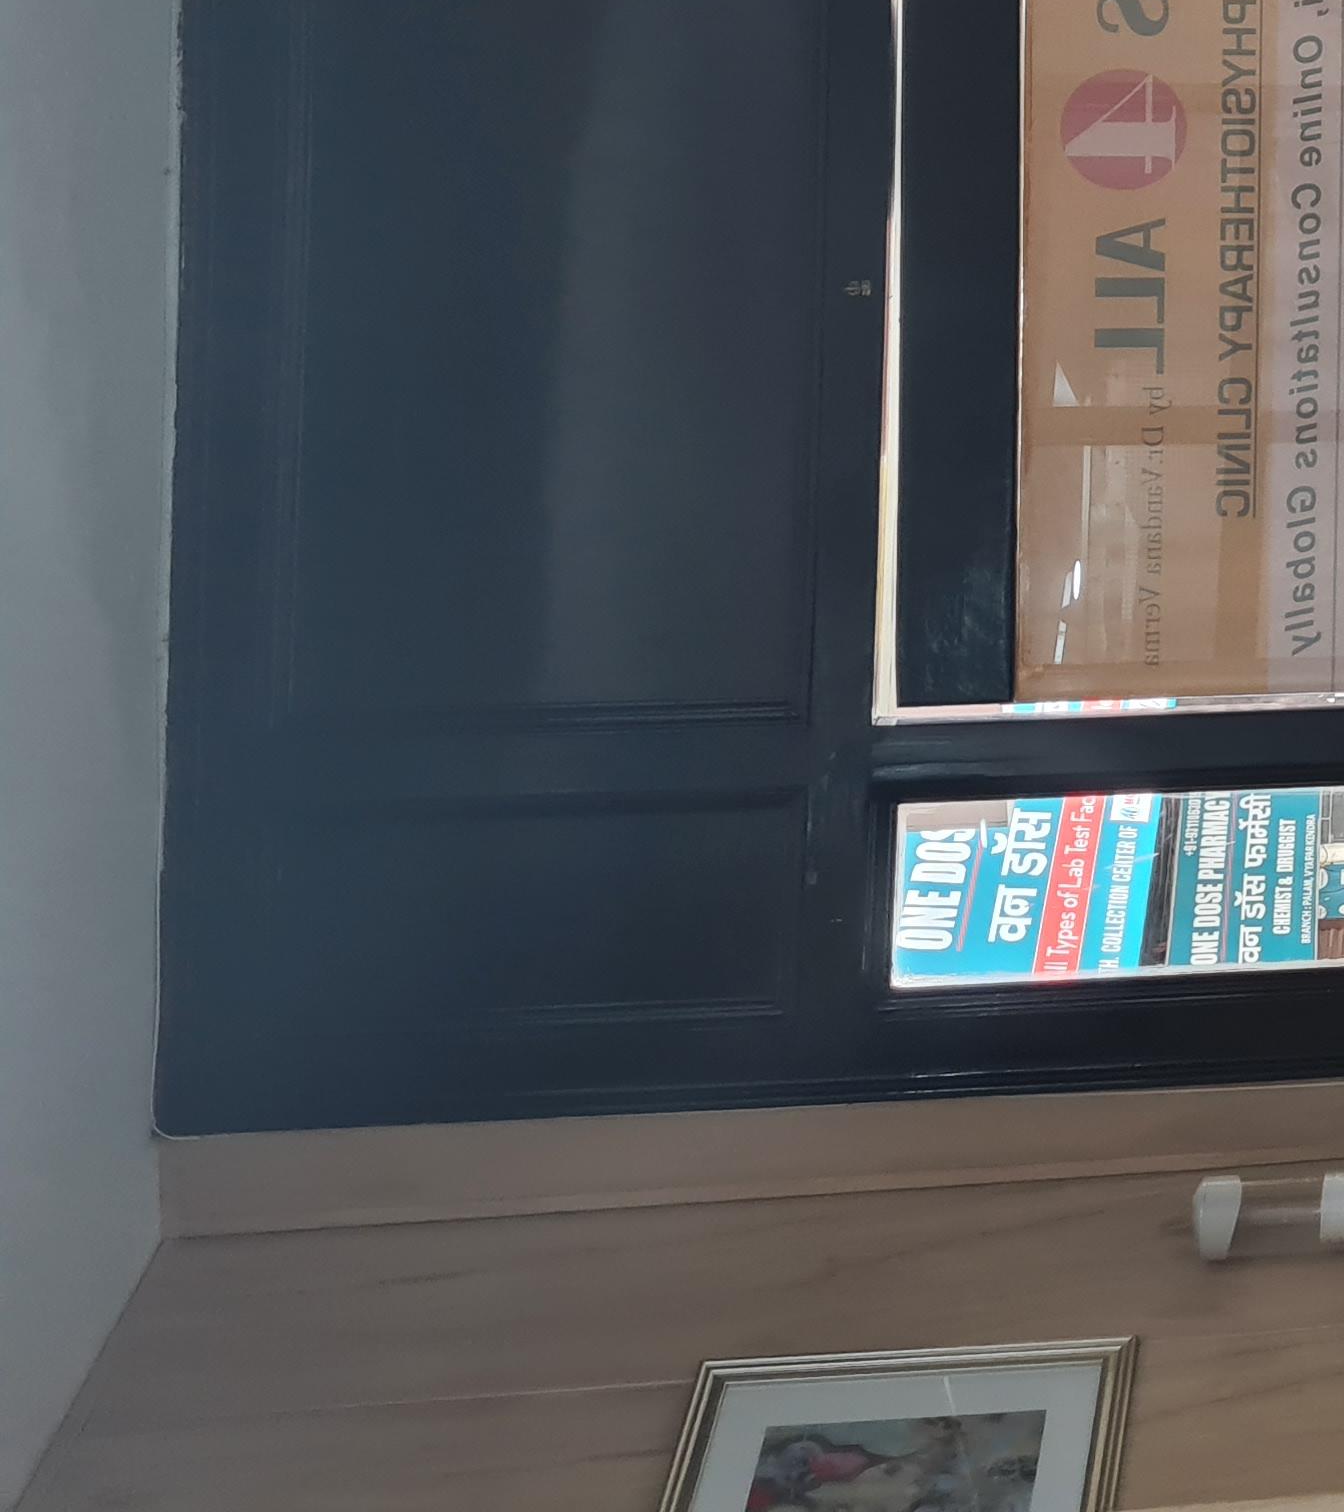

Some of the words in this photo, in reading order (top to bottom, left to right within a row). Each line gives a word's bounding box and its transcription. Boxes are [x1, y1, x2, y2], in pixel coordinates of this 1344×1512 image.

[991, 808, 1052, 876] डॉस
[1063, 825, 1091, 855] Test
[1118, 825, 1138, 838] OF
[1276, 819, 1296, 872] DRUGGIST
[1058, 858, 1084, 888] Lab
[1111, 842, 1136, 882] CENTER
[1279, 876, 1293, 885] &
[987, 884, 1038, 943] वन
[1056, 890, 1079, 908] of
[1194, 884, 1223, 927] DOSE
[1234, 873, 1266, 920] डॉस
[1273, 886, 1292, 934] CHEMIST
[896, 890, 962, 951] ONE
[1046, 912, 1079, 957] Types
[1101, 885, 1129, 952] COLLECTION
[1190, 931, 1219, 965] ONE
[1238, 924, 1262, 964] वन
